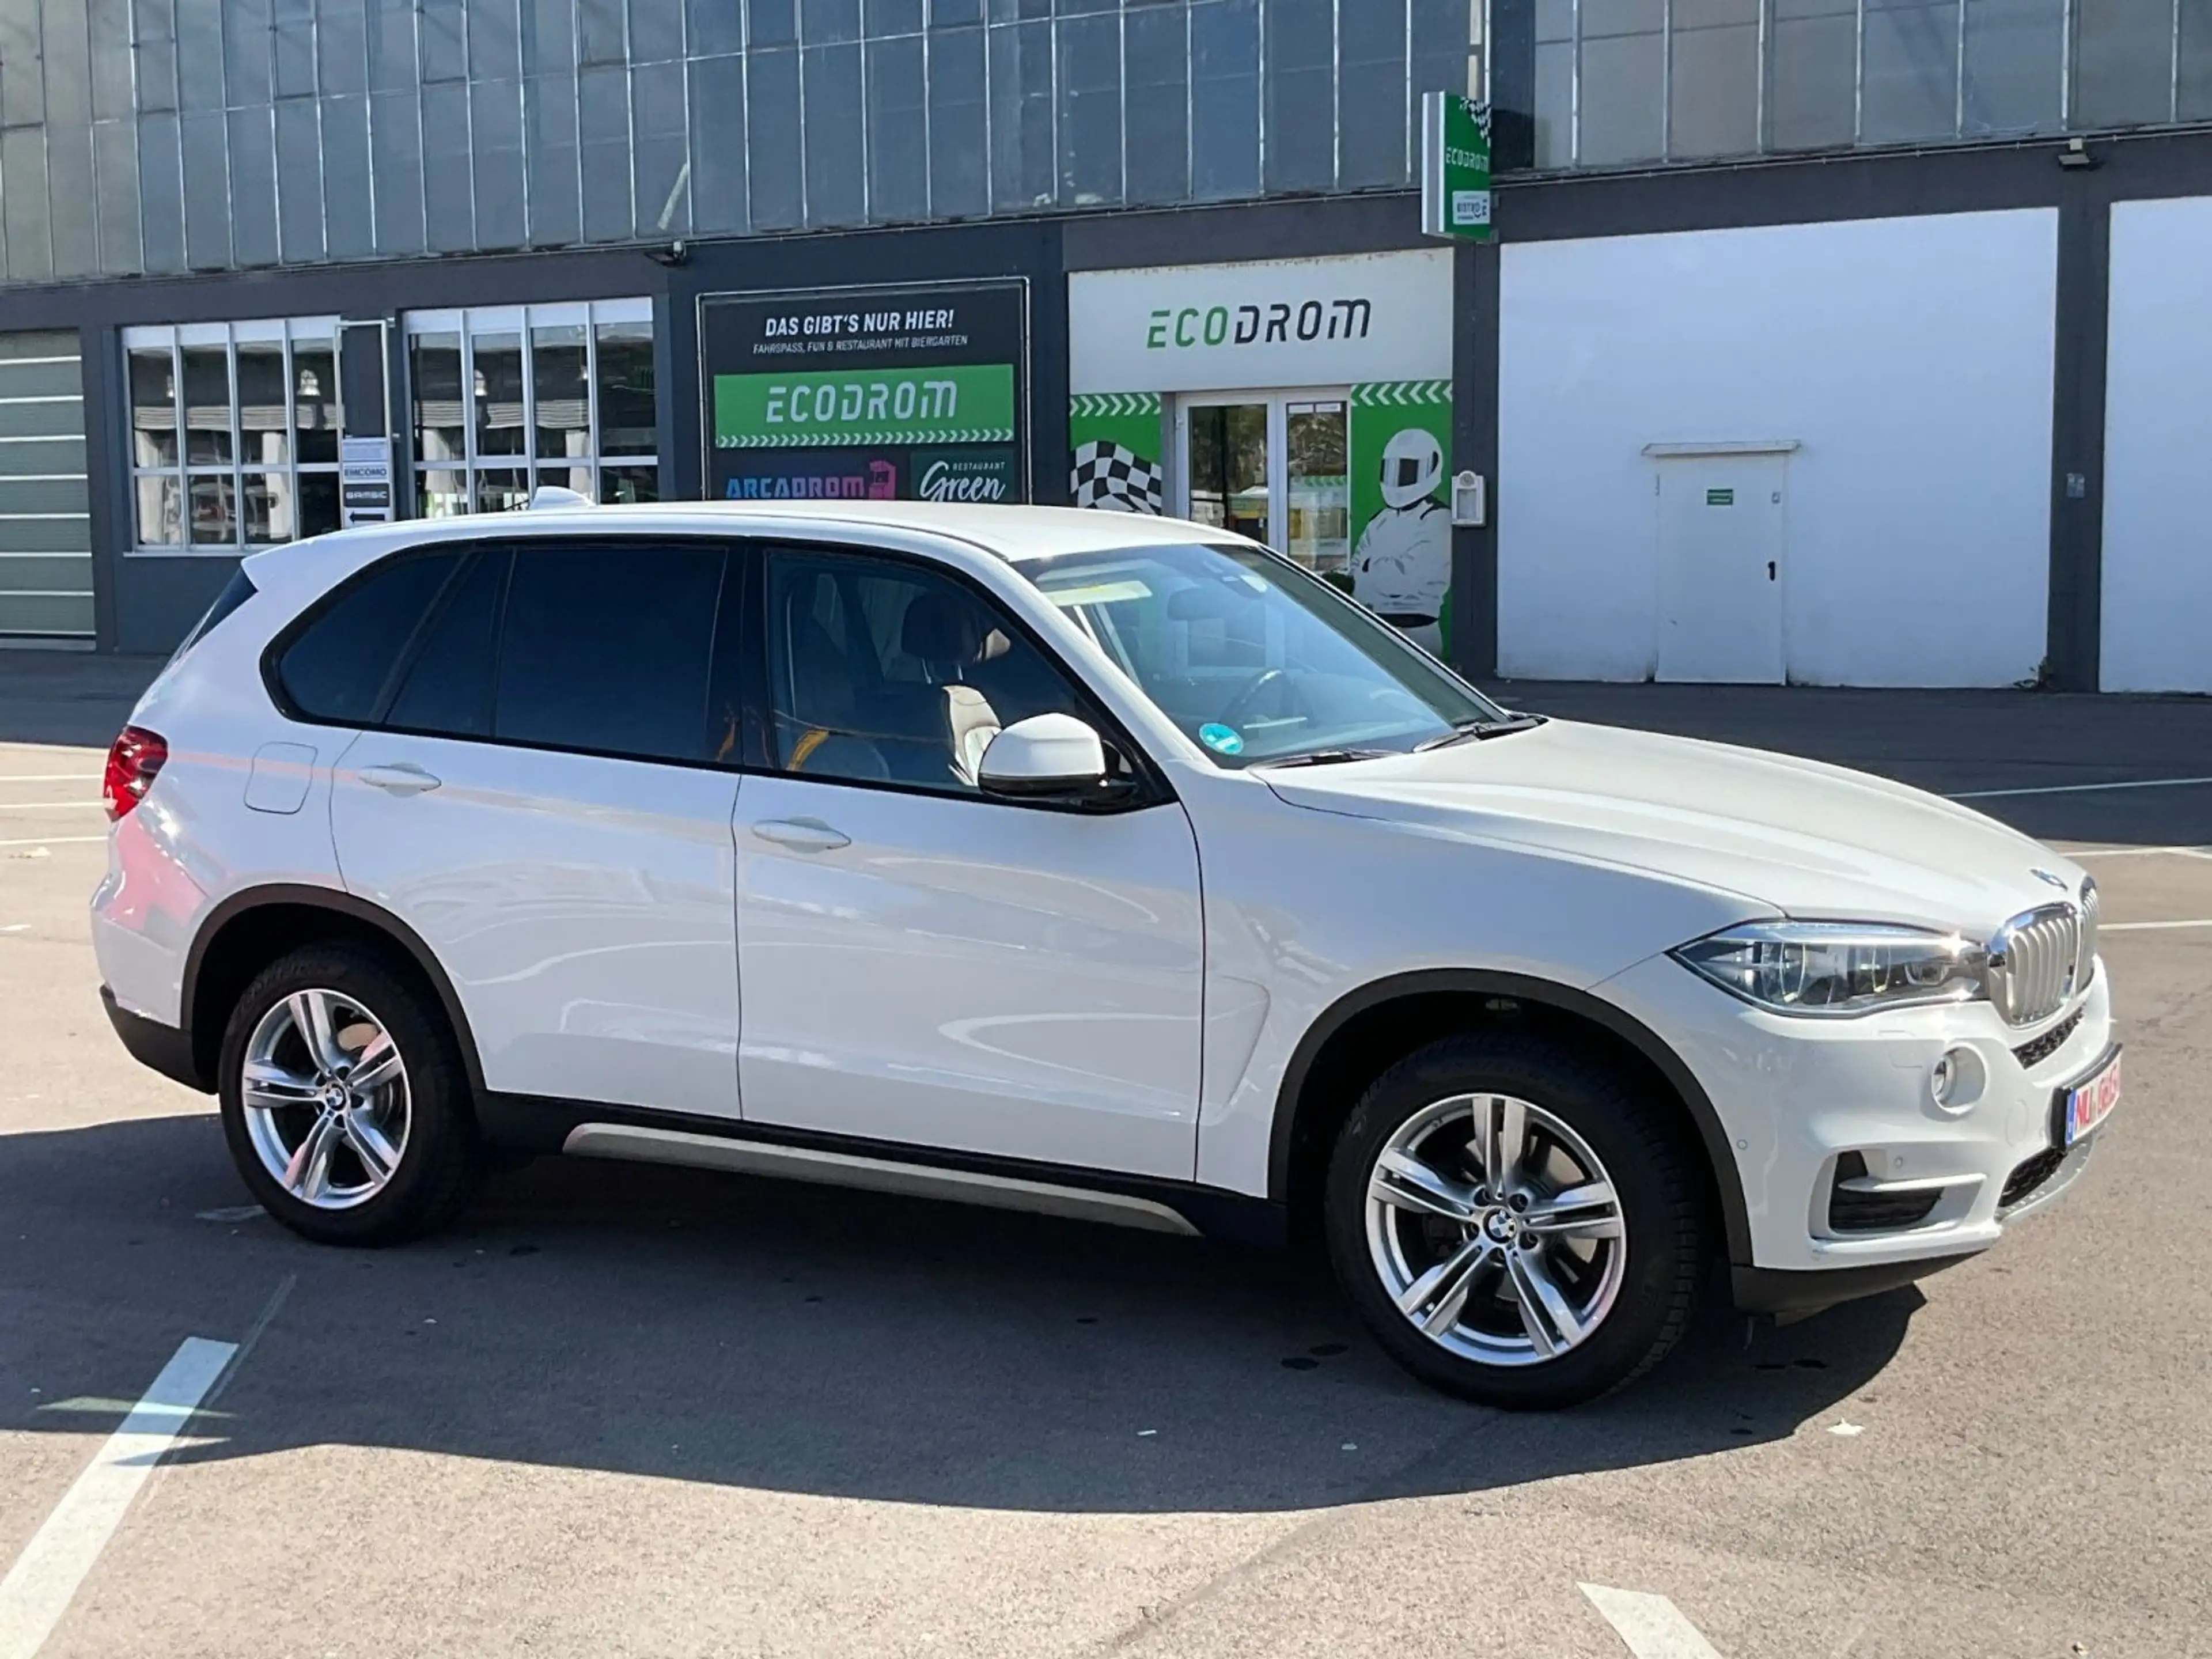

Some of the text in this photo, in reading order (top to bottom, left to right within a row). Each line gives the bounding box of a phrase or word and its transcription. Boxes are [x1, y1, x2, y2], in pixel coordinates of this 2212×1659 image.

[1446, 146, 1488, 172] ECODROM
[765, 317, 799, 336] DAS
[863, 312, 900, 332] NUR
[905, 309, 954, 330] HIER!
[1146, 298, 1371, 349] ECODROM
[753, 342, 806, 354] FAHRSPASS,
[807, 341, 826, 353] FUN
[836, 338, 892, 351] RESTAURANT
[894, 337, 910, 349] MIT
[911, 335, 968, 348] BIERGARTEN
[766, 381, 957, 423] ECODROM
[953, 462, 1006, 471] RESTAURANT
[726, 476, 864, 498] ARCADROM
[919, 460, 1006, 502] Green
